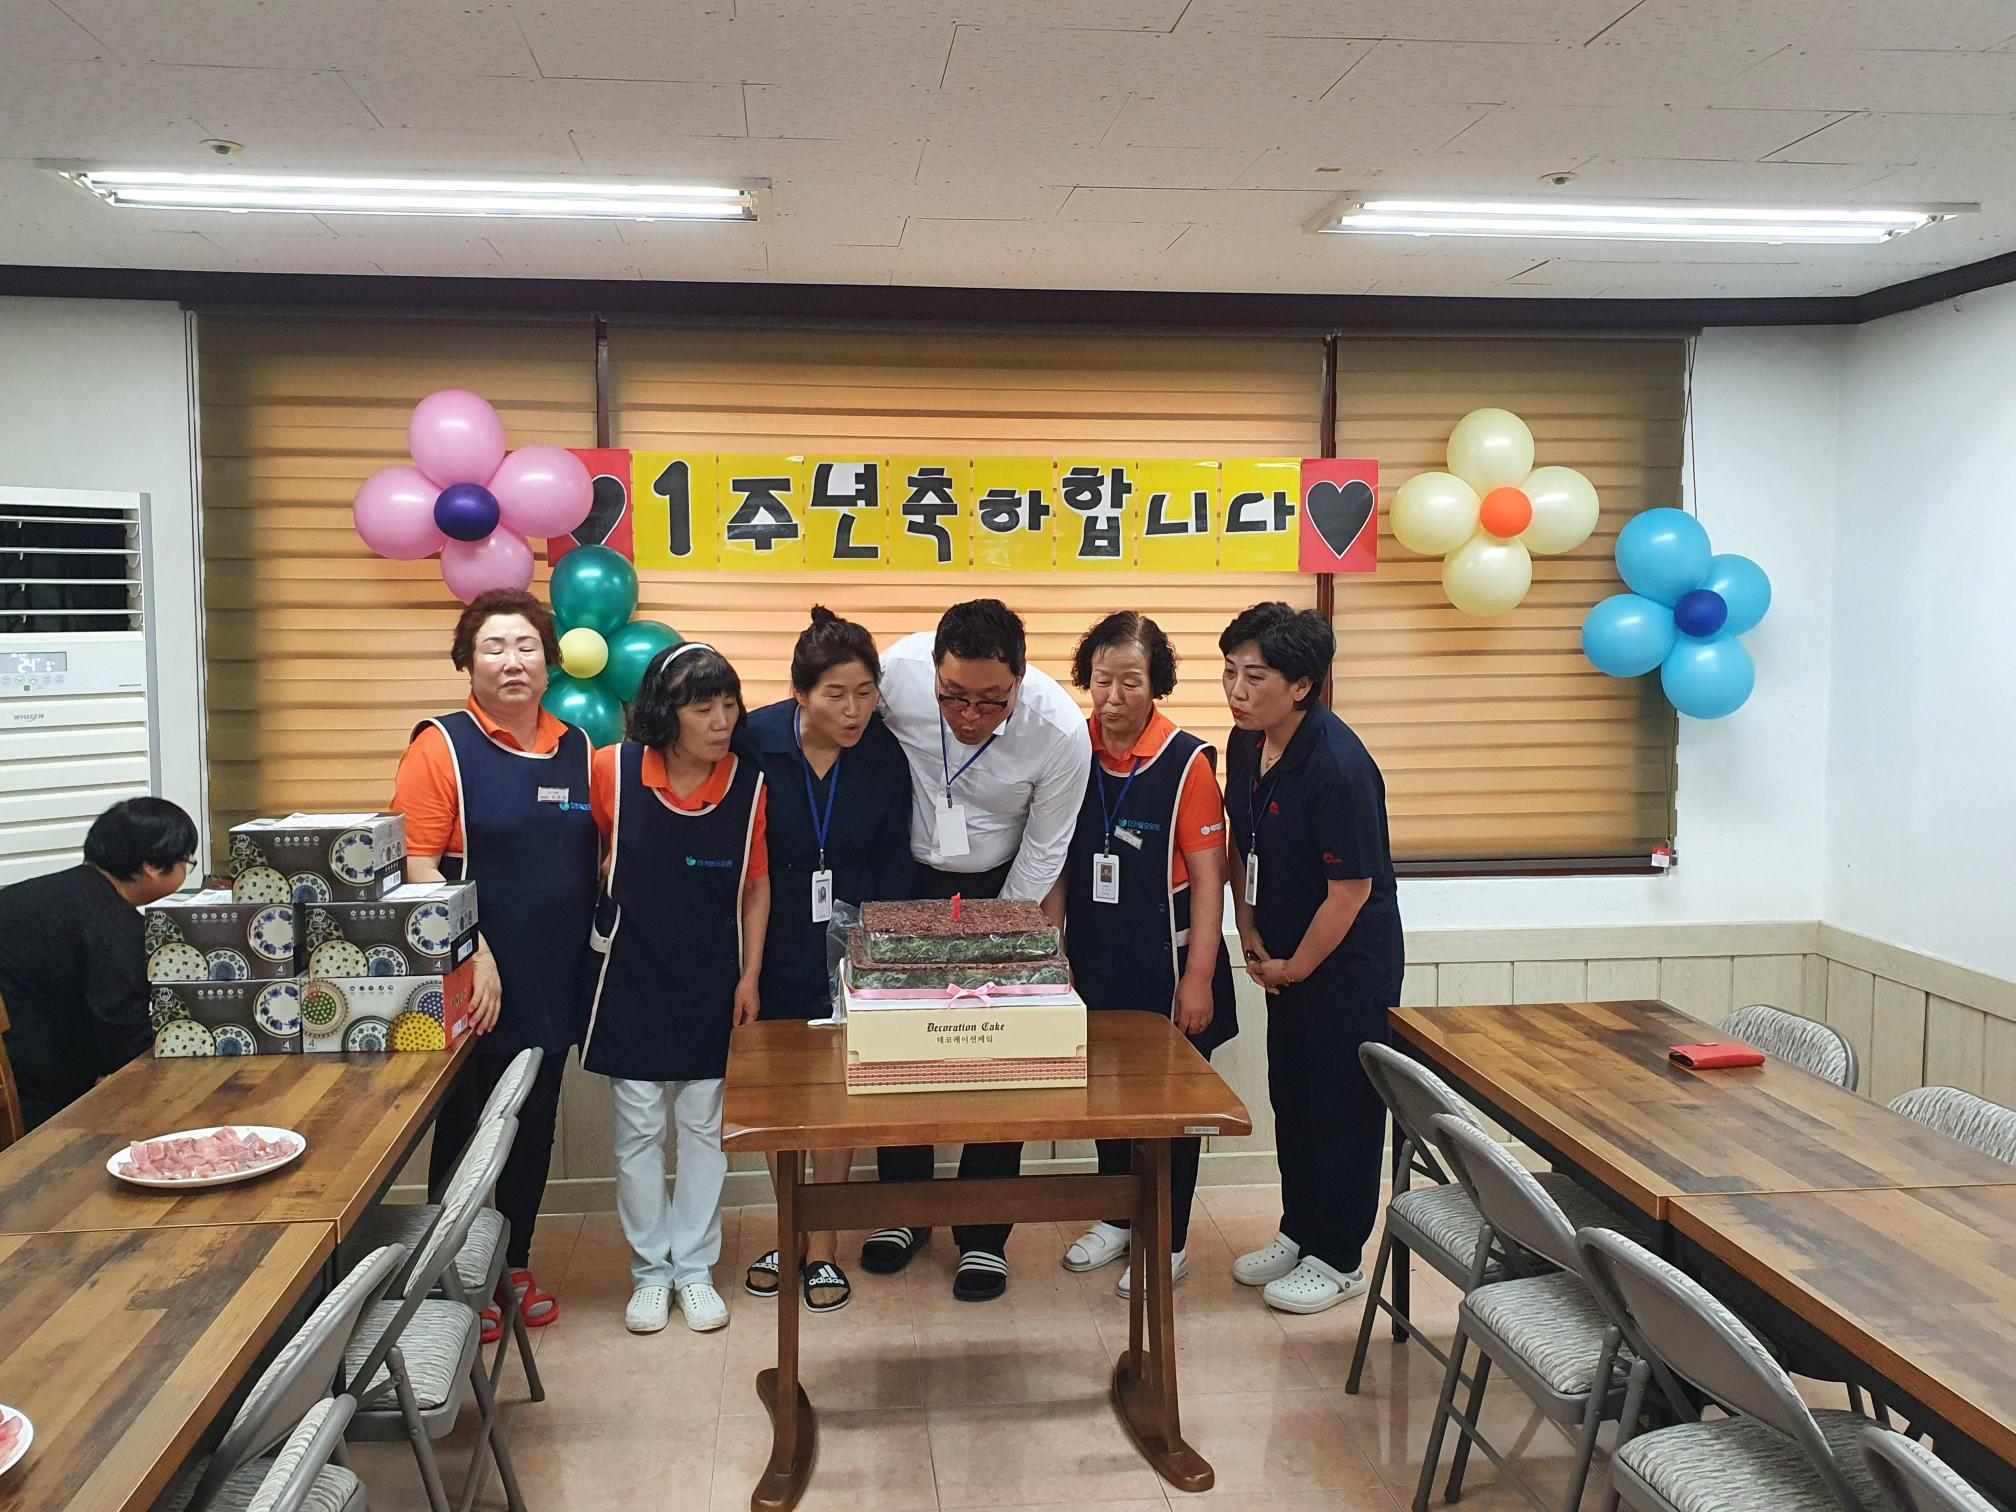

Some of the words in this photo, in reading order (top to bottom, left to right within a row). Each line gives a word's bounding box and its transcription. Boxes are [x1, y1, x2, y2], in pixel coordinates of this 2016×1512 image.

[927, 1022, 977, 1032] Decoration
[981, 1022, 1005, 1032] Cake
[809, 1276, 845, 1286] adidas
